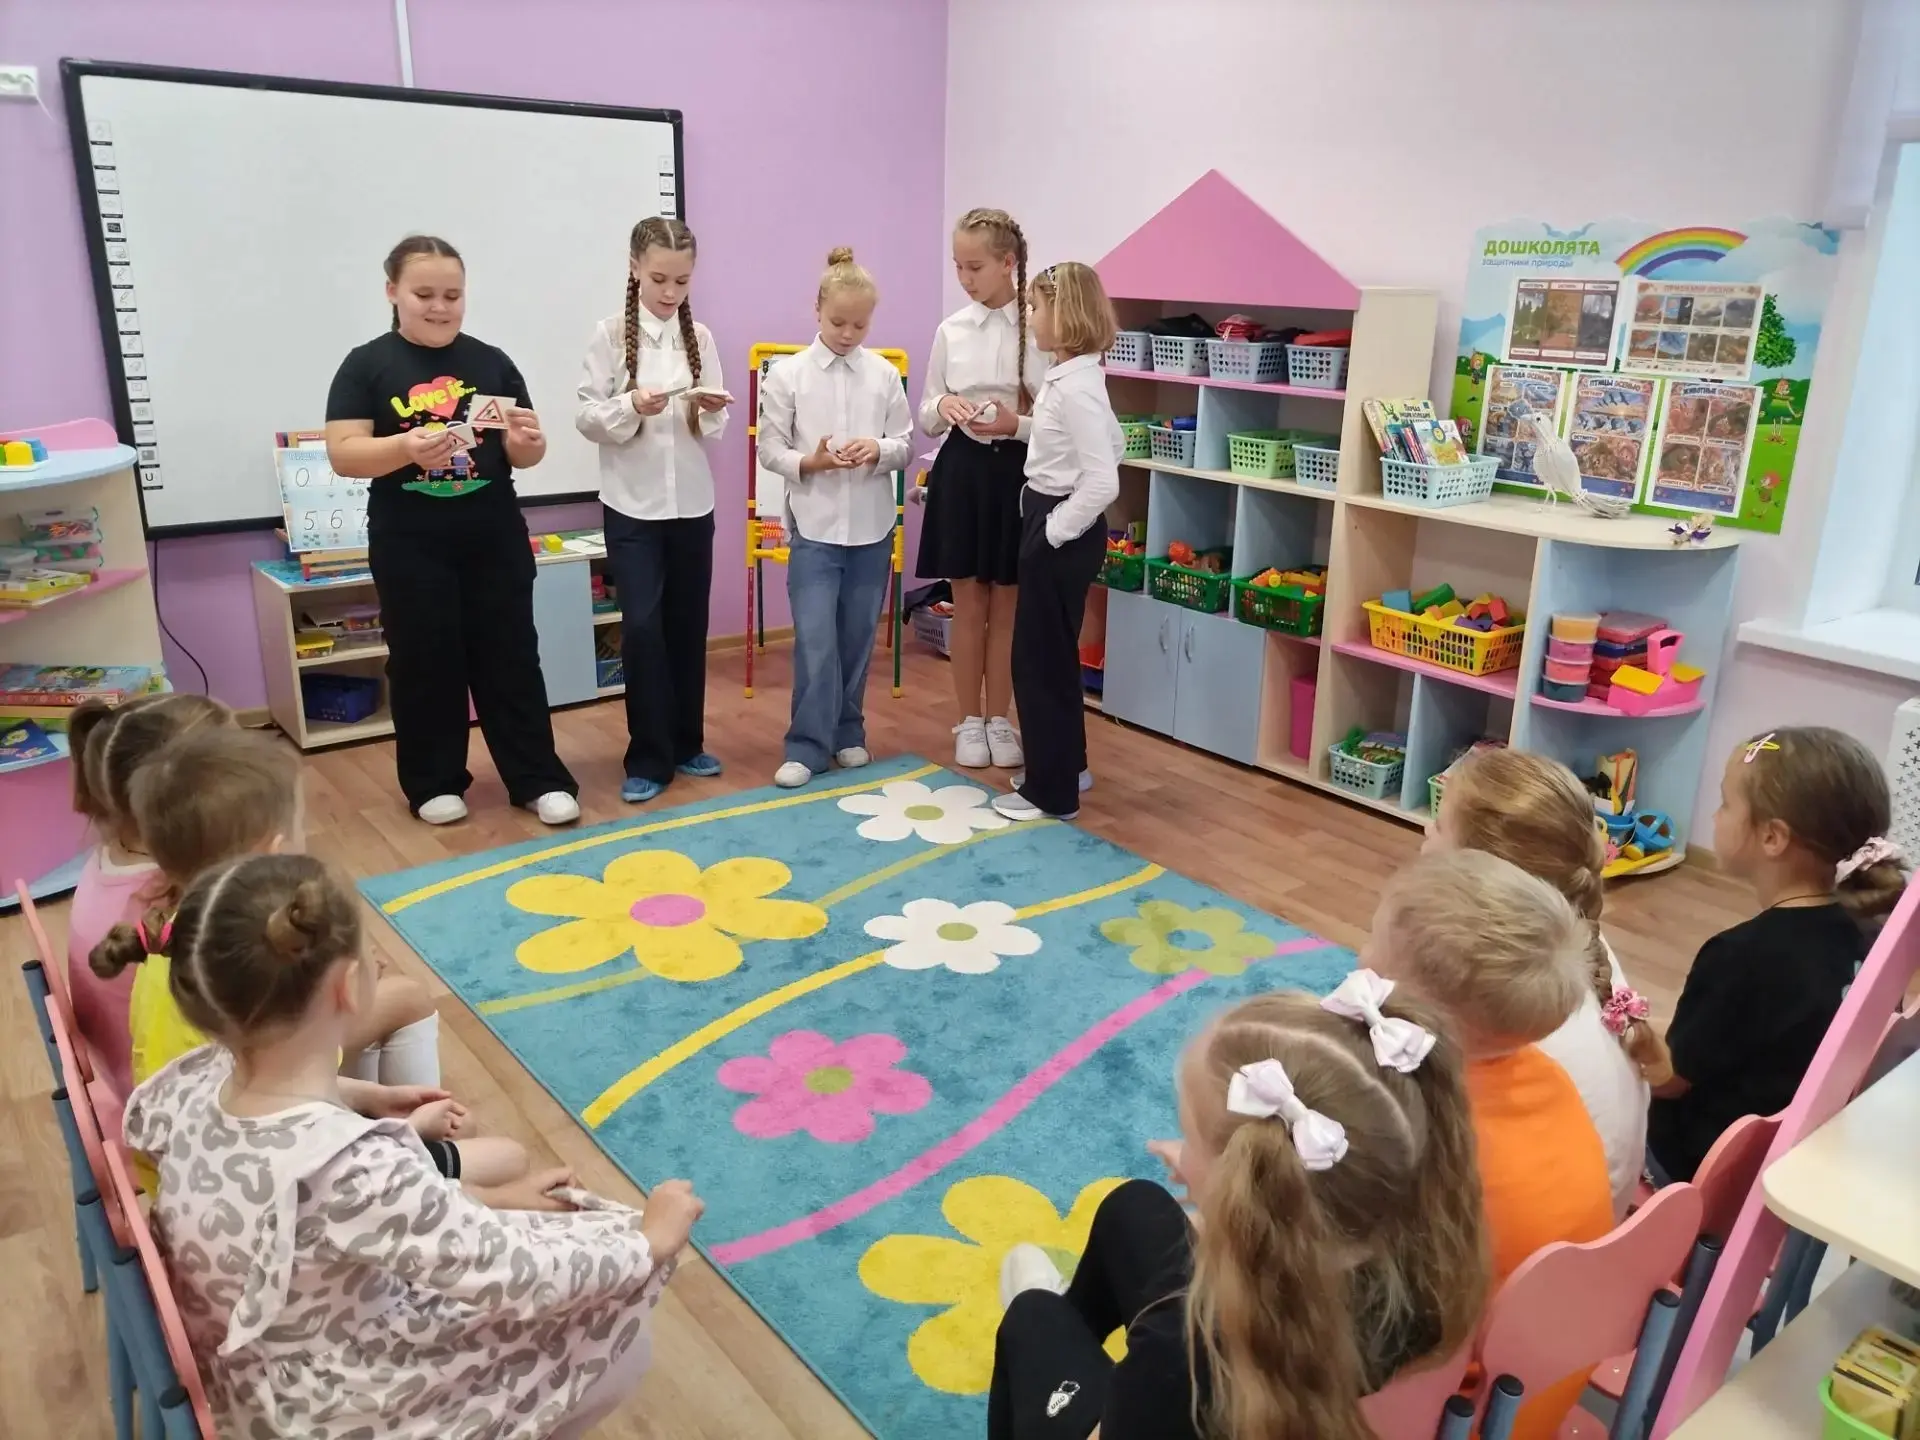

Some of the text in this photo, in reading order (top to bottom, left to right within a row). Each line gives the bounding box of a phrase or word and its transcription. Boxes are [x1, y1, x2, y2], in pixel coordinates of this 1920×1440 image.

[1484, 240, 1600, 256] ДОШКОЛЯТА
[391, 389, 448, 418] Love
[296, 467, 309, 487] 0
[304, 510, 317, 531] 5
[330, 509, 343, 529] 6
